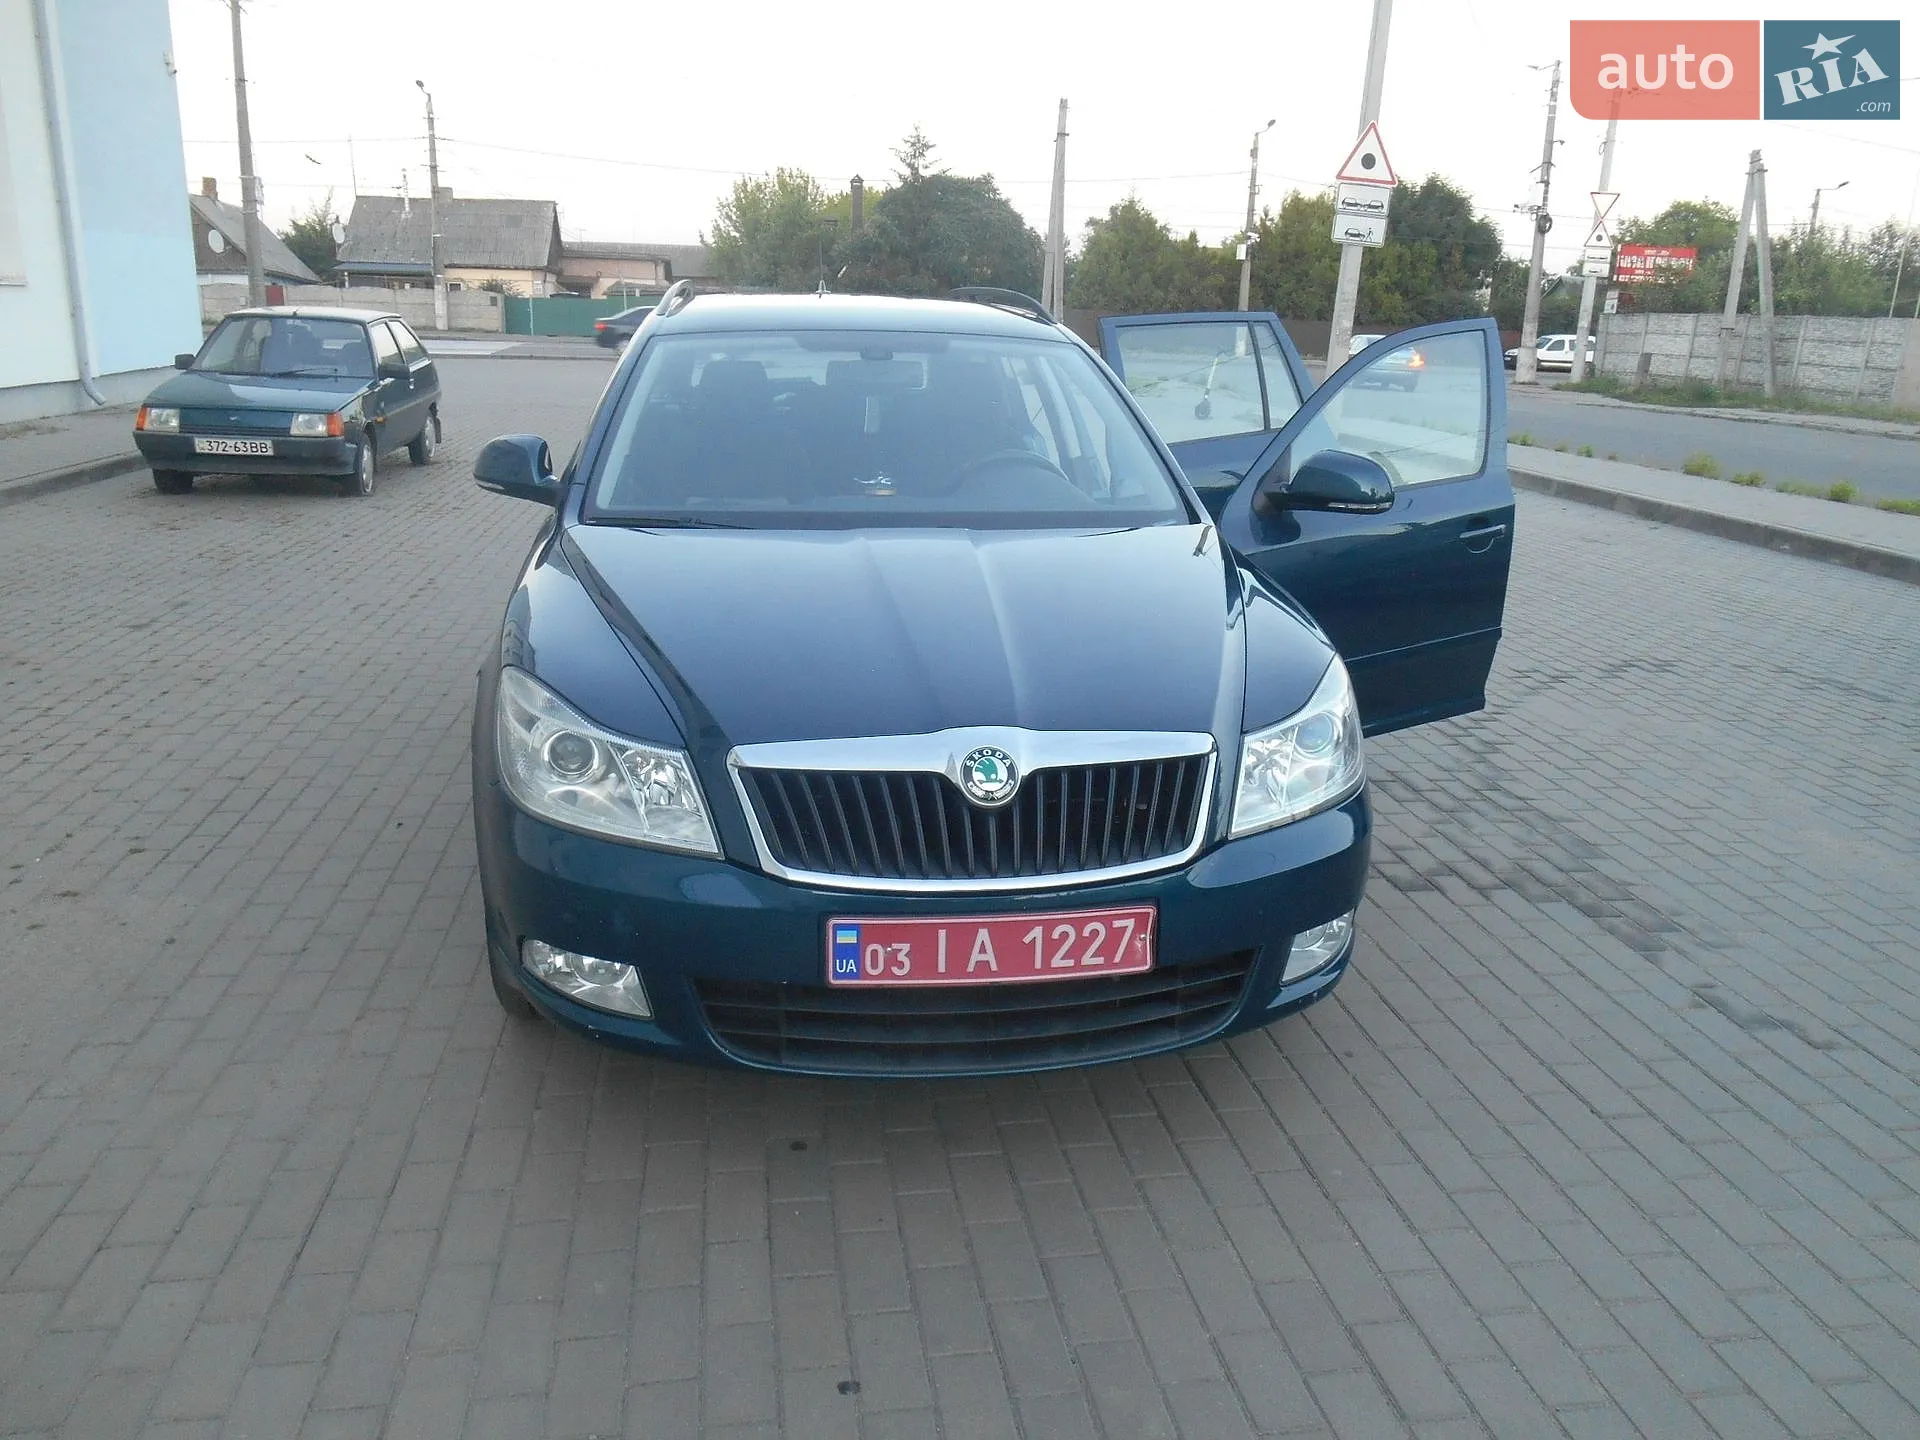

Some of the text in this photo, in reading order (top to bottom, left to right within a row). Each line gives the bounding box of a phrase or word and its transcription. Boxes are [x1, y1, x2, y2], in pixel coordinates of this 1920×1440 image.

[864, 943, 911, 977] 03
[1022, 918, 1136, 970] 1227
[836, 959, 857, 973] UA
